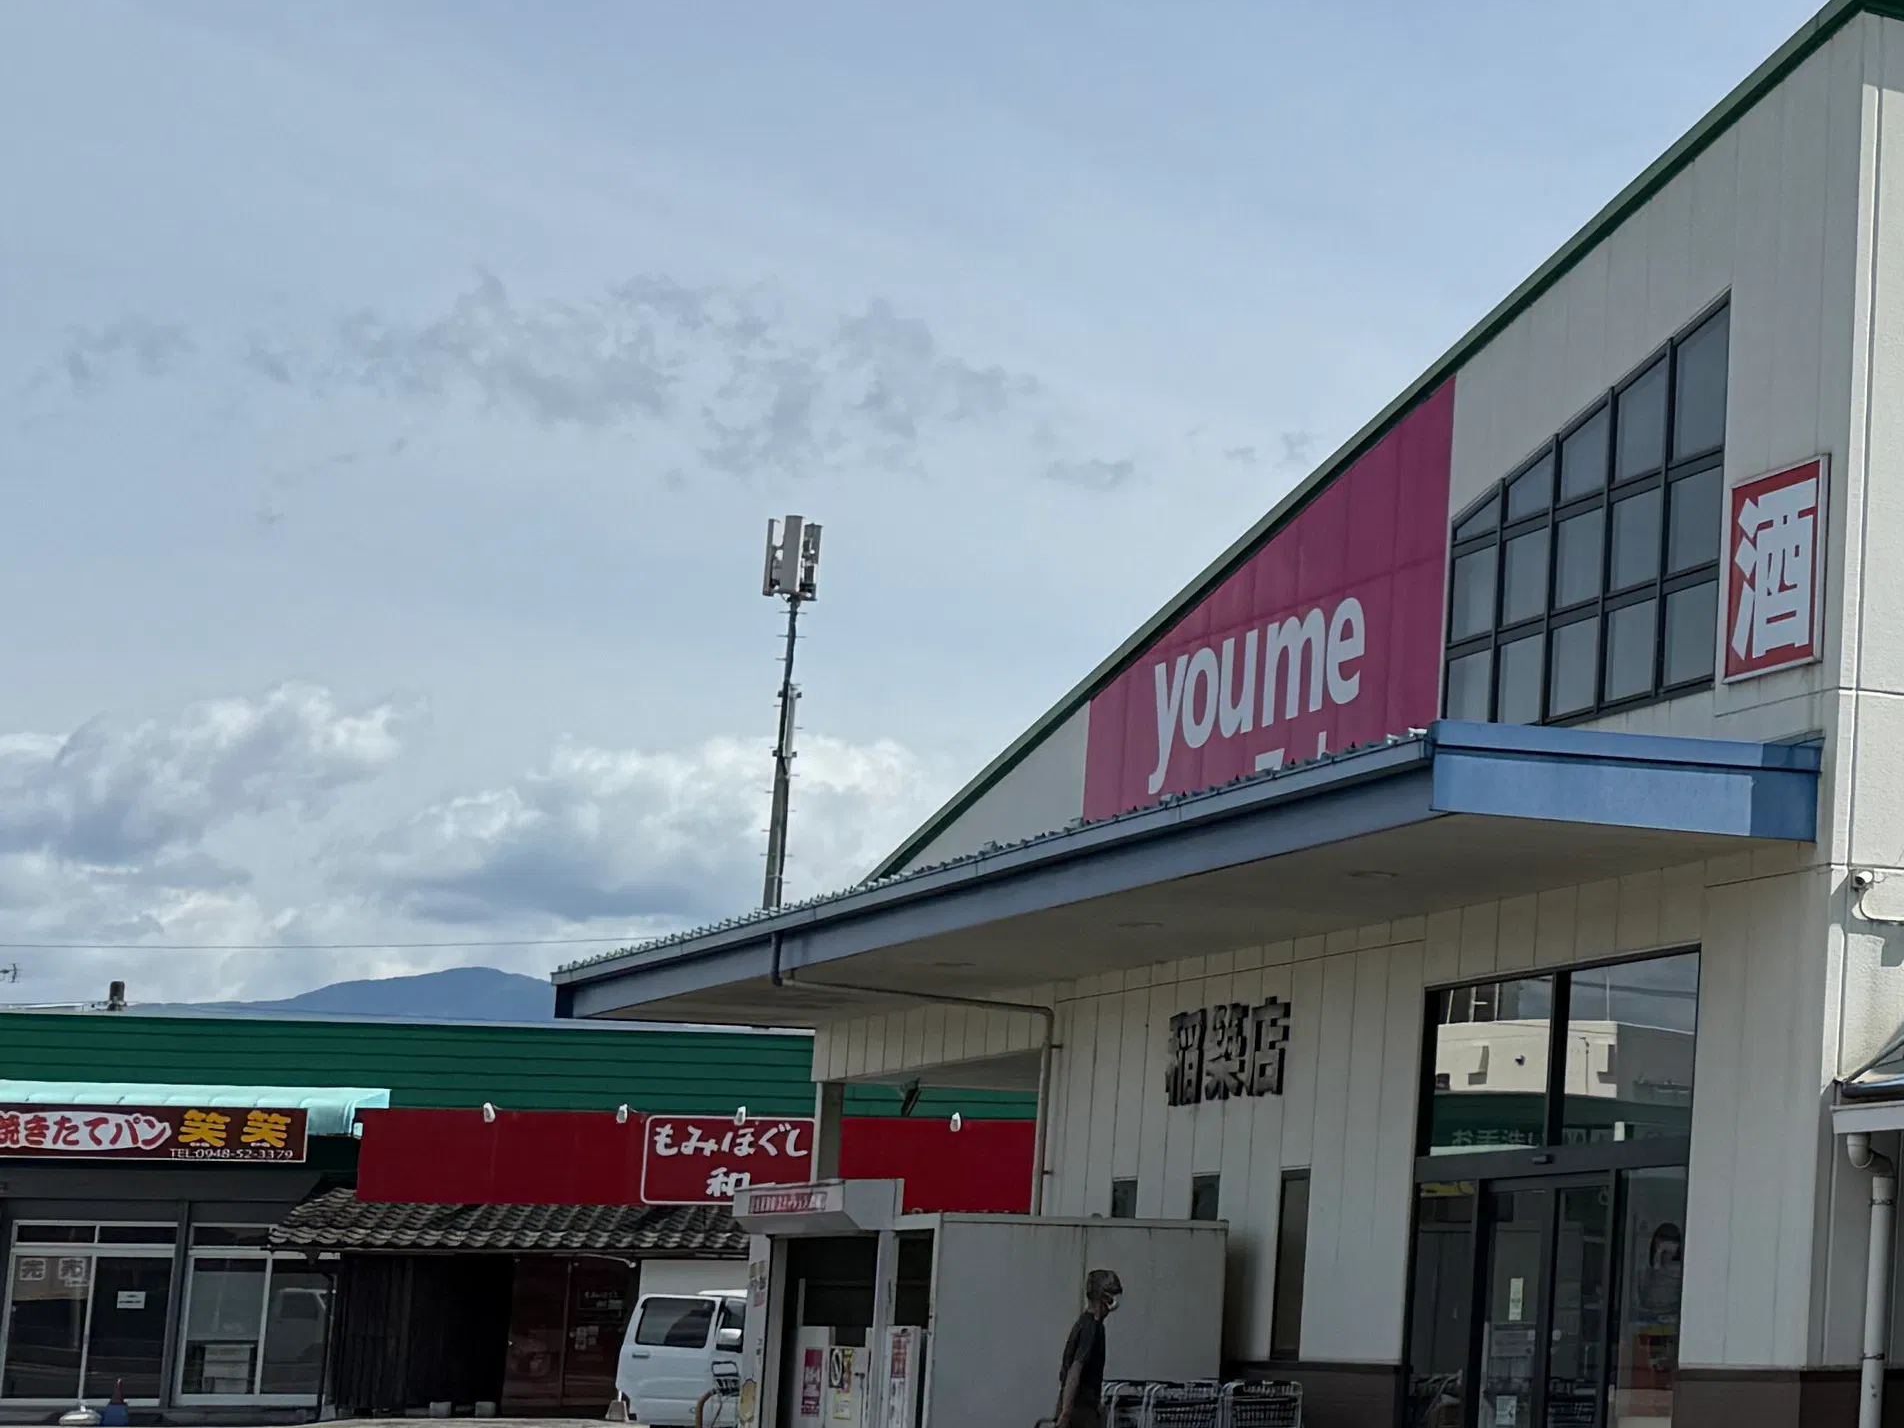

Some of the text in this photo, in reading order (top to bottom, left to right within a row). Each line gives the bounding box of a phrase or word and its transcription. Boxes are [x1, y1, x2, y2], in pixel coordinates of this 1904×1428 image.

[1731, 477, 1820, 661] 酒
[1148, 597, 1366, 795] youme
[654, 1123, 808, 1157] もみほぐし
